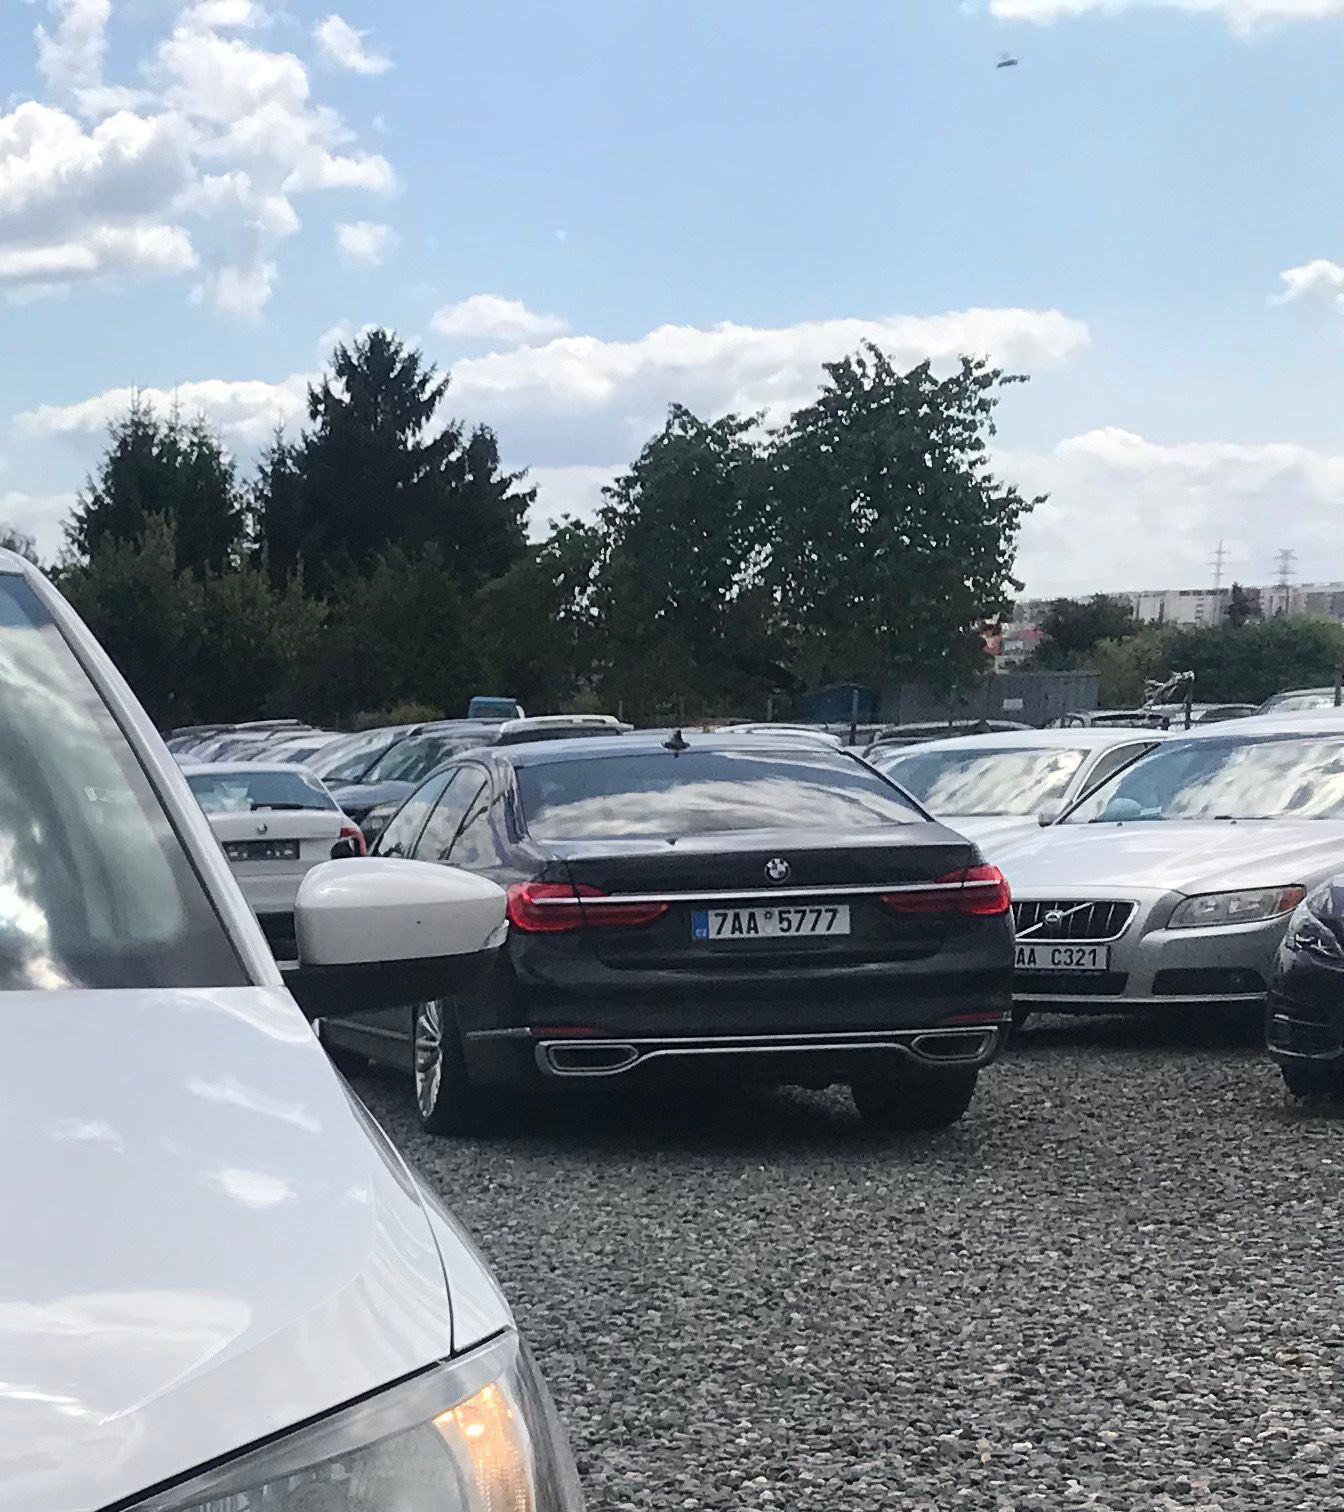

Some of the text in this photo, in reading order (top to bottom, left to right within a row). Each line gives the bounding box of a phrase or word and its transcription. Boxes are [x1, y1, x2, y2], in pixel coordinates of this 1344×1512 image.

[714, 908, 839, 936] 7AA 5777
[1051, 949, 1097, 967] C321
